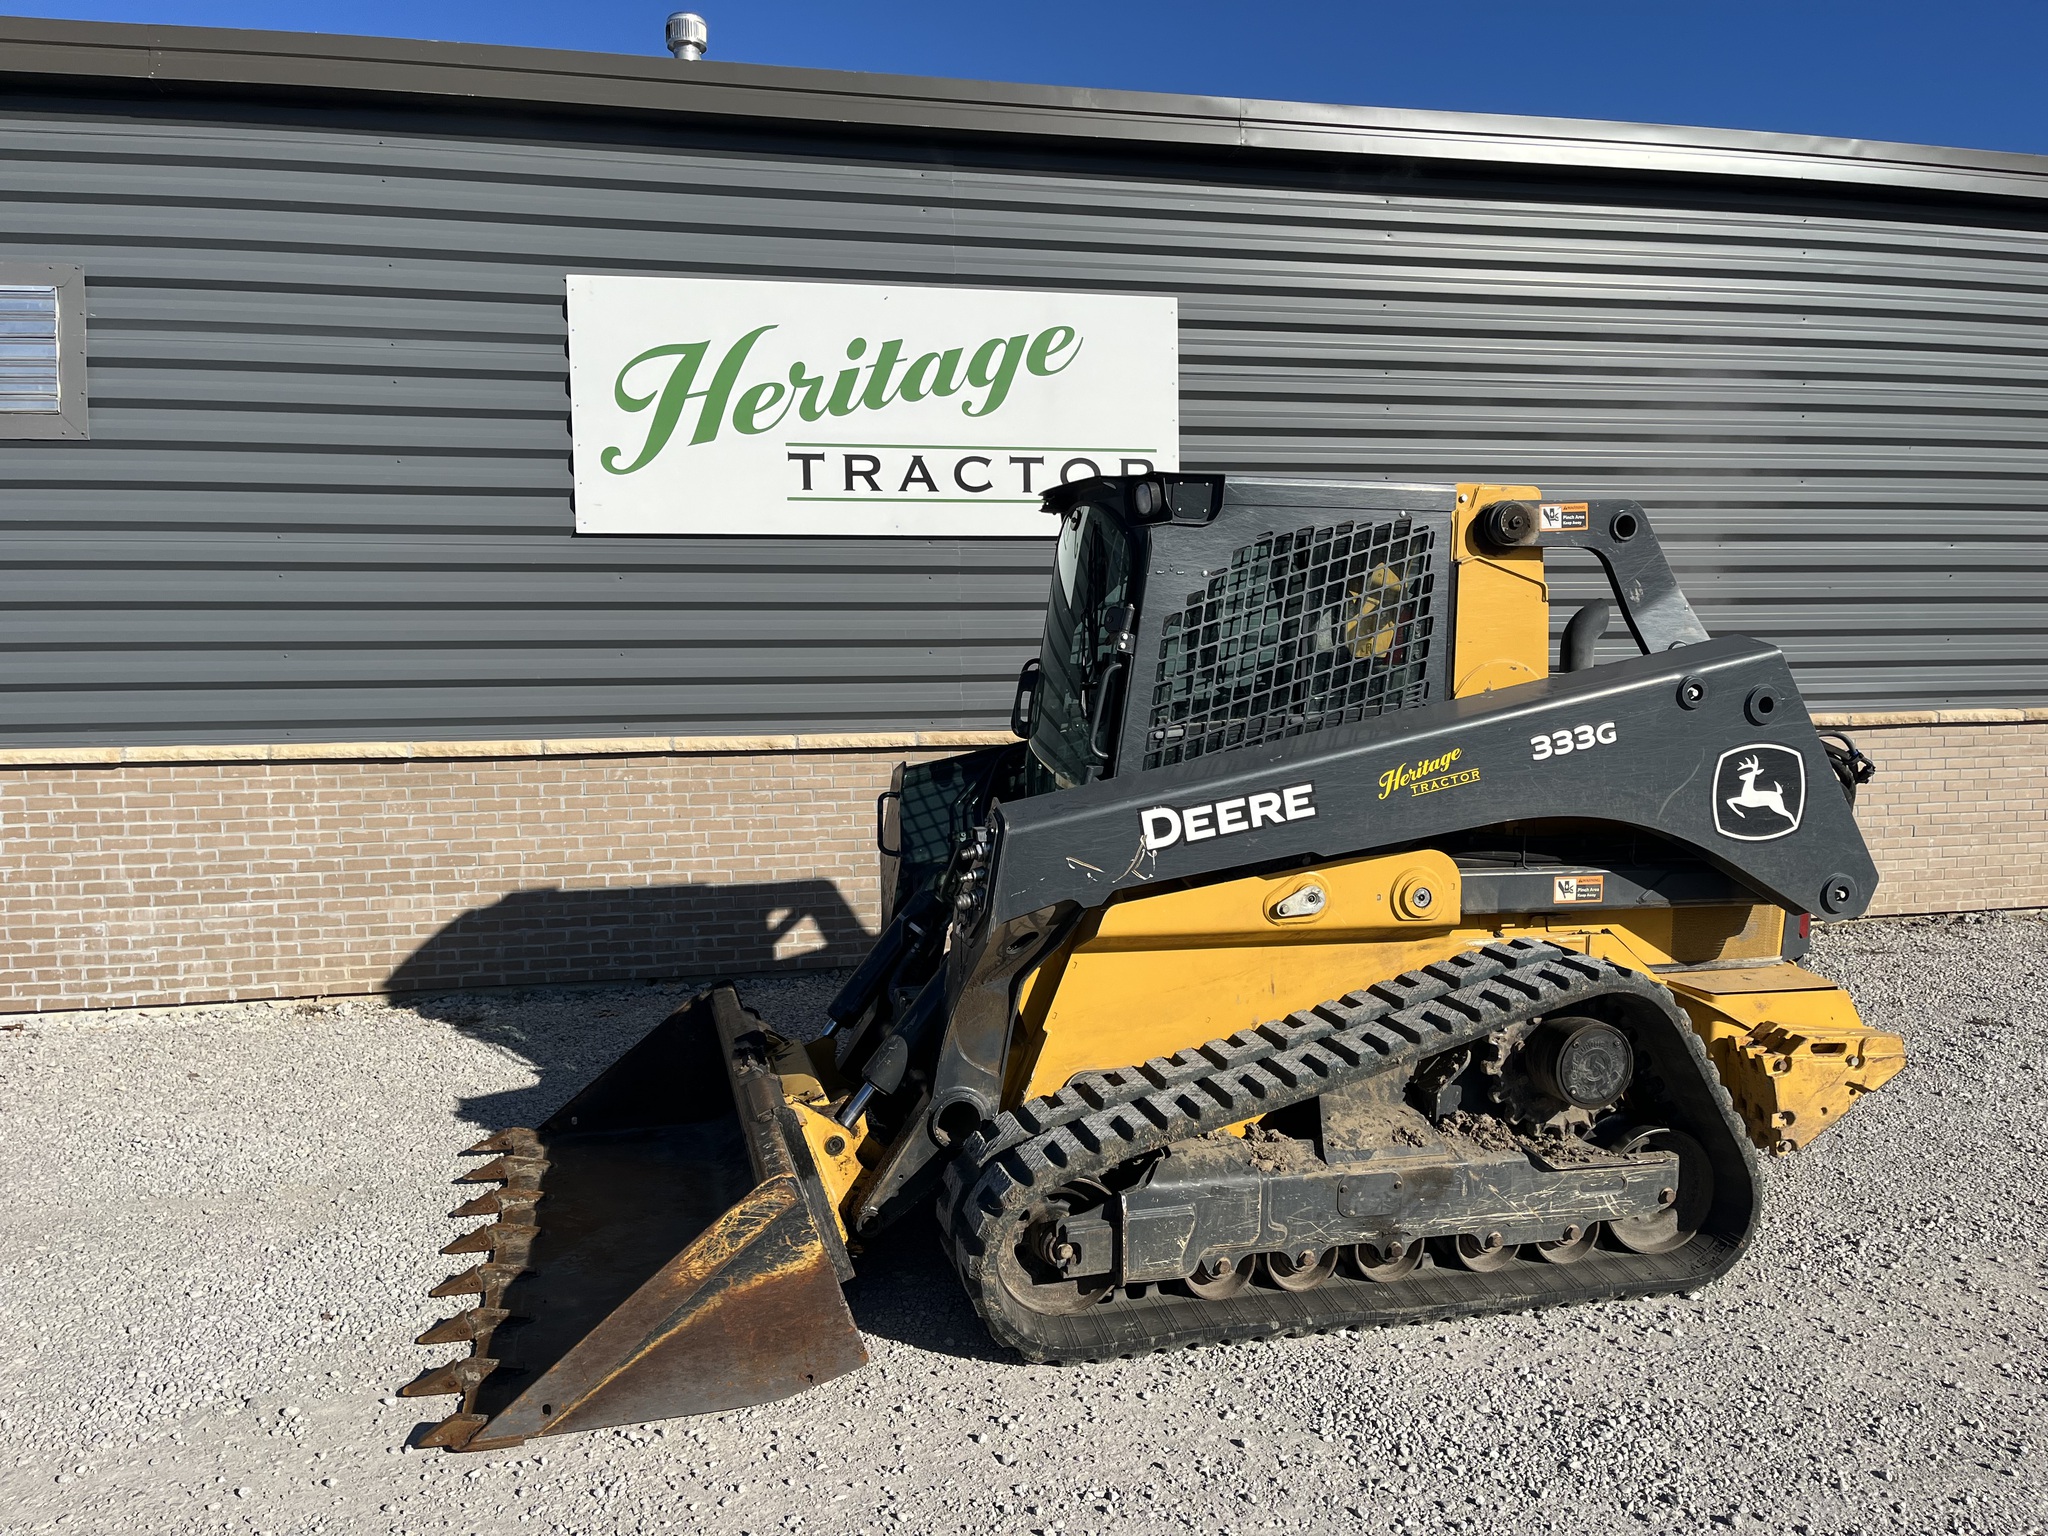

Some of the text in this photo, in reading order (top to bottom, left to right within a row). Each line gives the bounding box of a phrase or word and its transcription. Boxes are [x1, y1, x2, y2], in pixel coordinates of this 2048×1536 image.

[600, 324, 1084, 475] Heritage
[1530, 722, 1617, 761] 333G
[1378, 747, 1463, 800] Heritage
[1410, 770, 1480, 794] TRACTOR
[1140, 783, 1316, 850] DEERE
